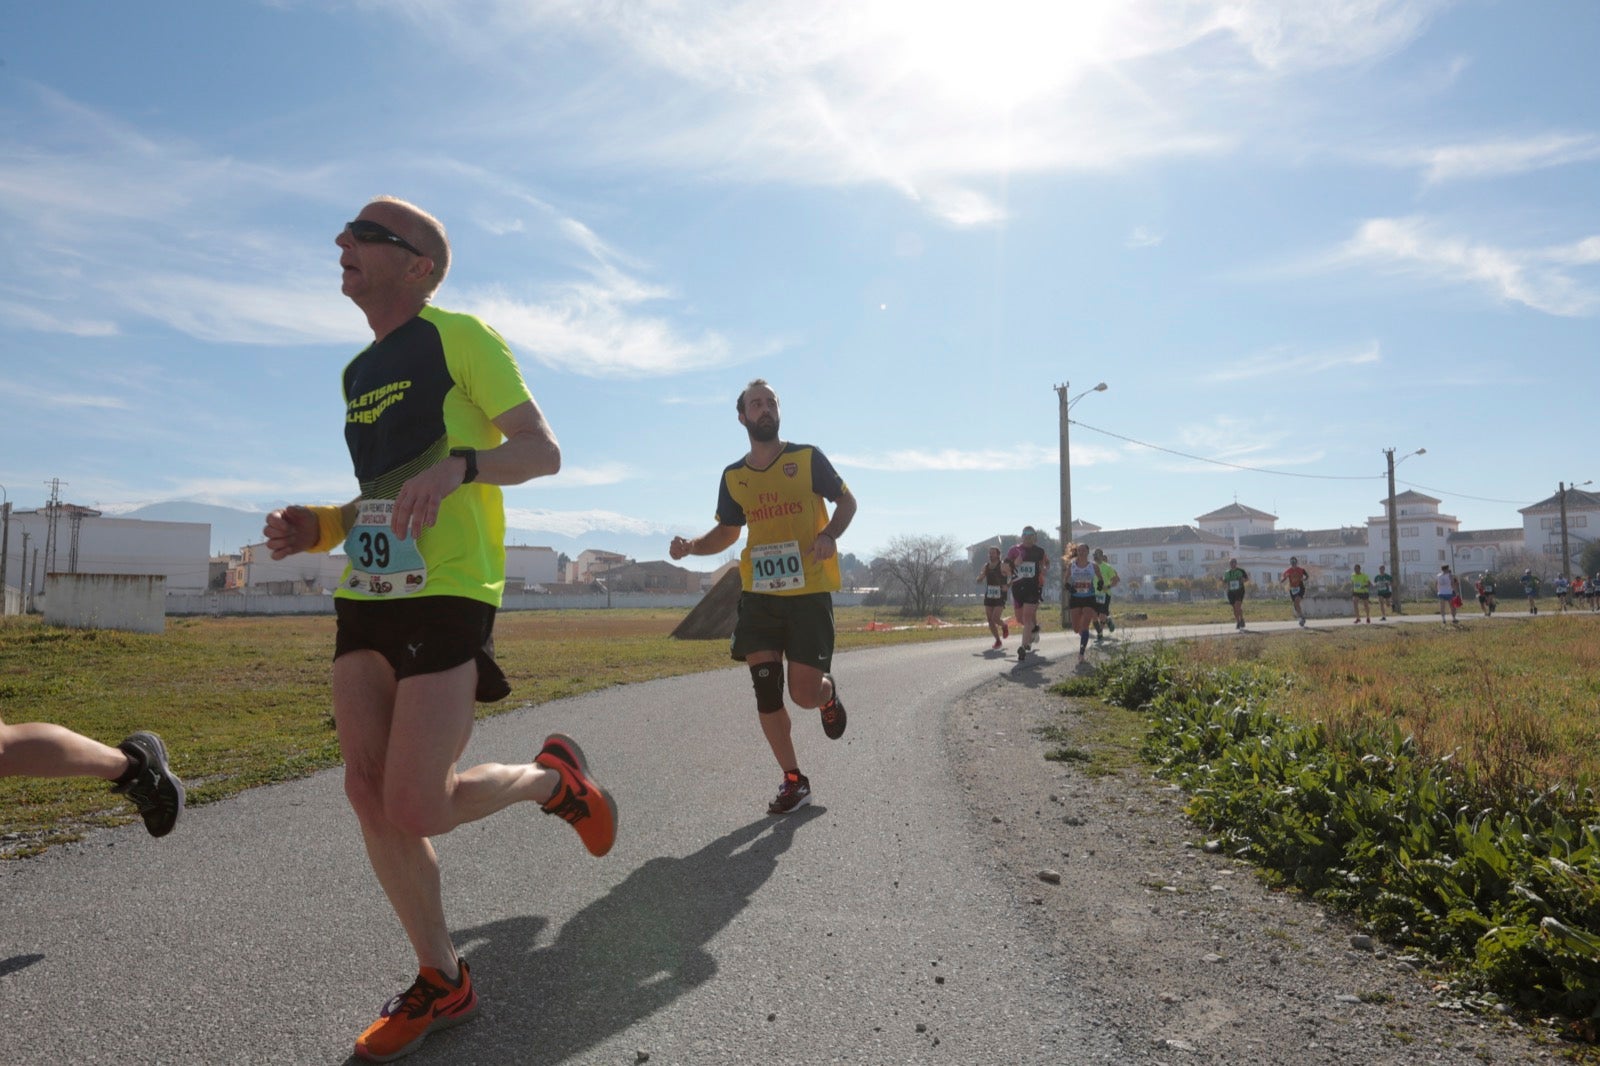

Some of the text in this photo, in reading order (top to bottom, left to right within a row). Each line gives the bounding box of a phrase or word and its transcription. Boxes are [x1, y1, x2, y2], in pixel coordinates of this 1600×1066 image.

[758, 491, 778, 504] Fly
[359, 532, 390, 568] 39
[755, 556, 800, 577] 1010
